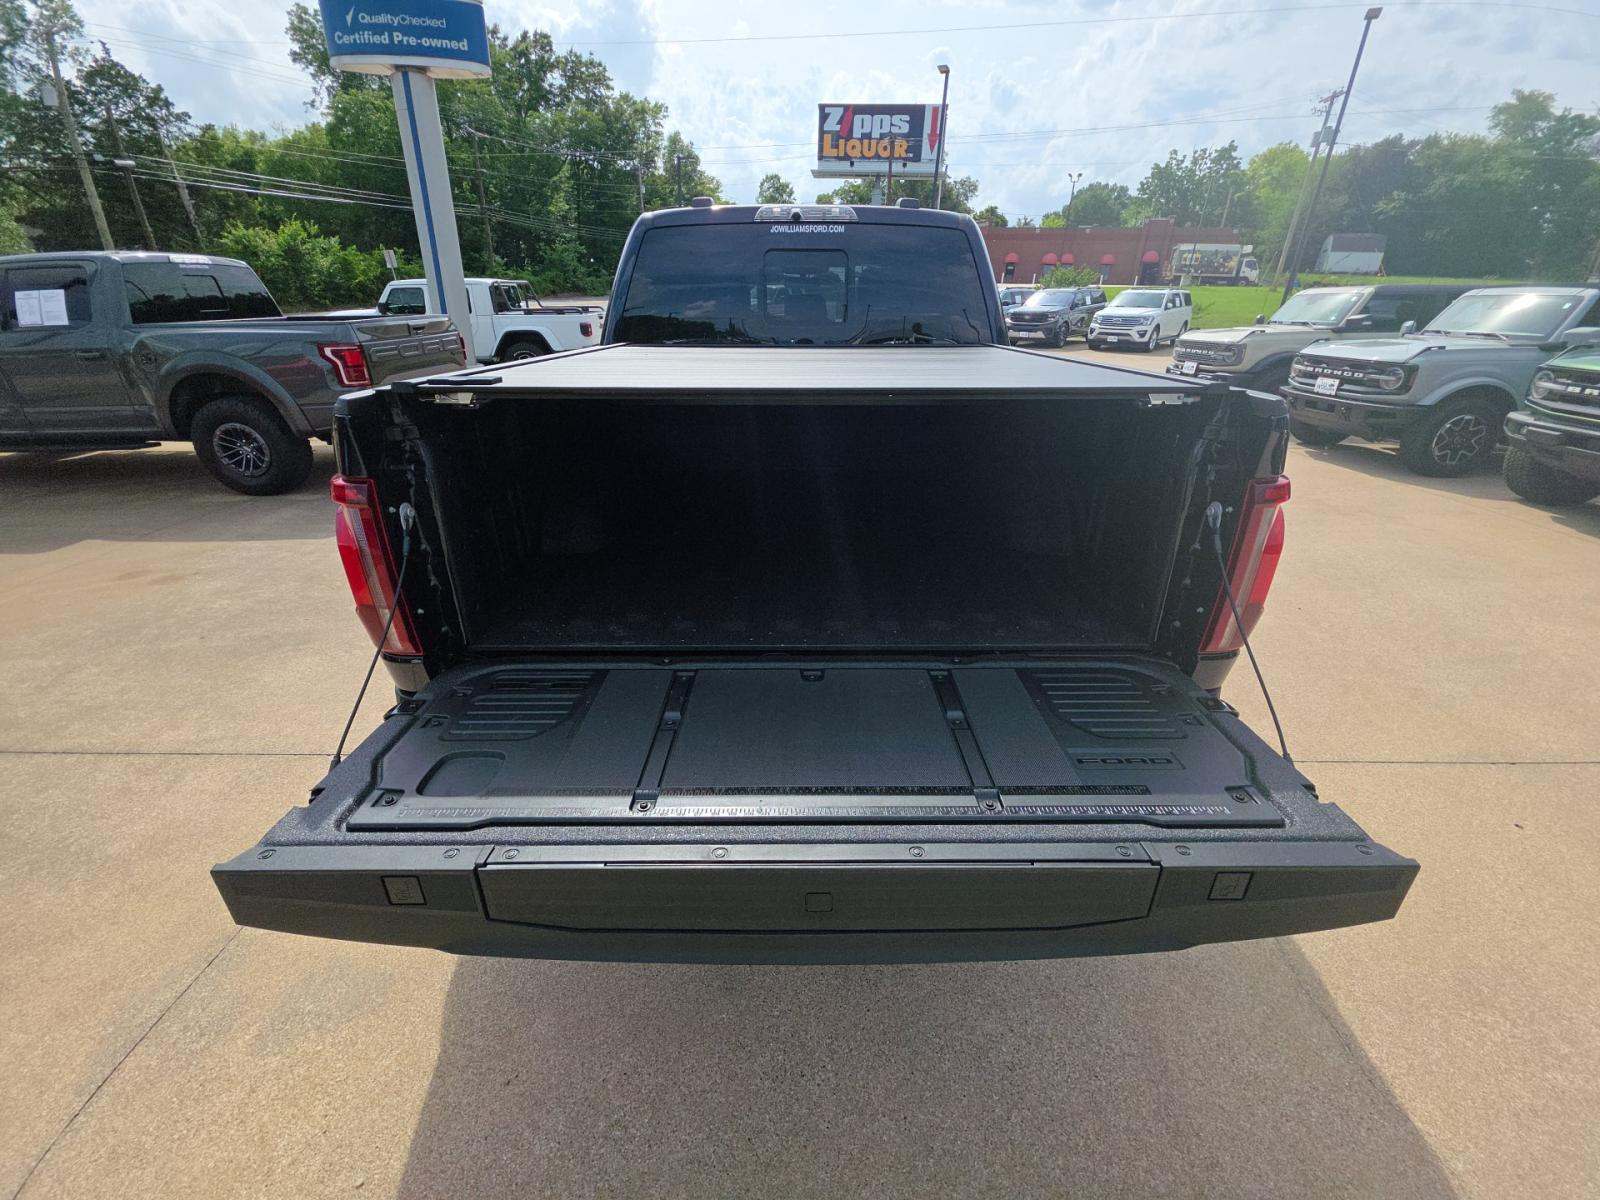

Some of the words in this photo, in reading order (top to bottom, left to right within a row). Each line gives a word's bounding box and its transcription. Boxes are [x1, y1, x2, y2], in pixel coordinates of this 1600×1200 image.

[358, 12, 447, 29] QualityChecked
[334, 31, 389, 45] Certified
[392, 32, 468, 51] Pre-owned
[769, 225, 845, 233] JOWILLIAMSFORD.COM
[1076, 757, 1174, 765] FORD
